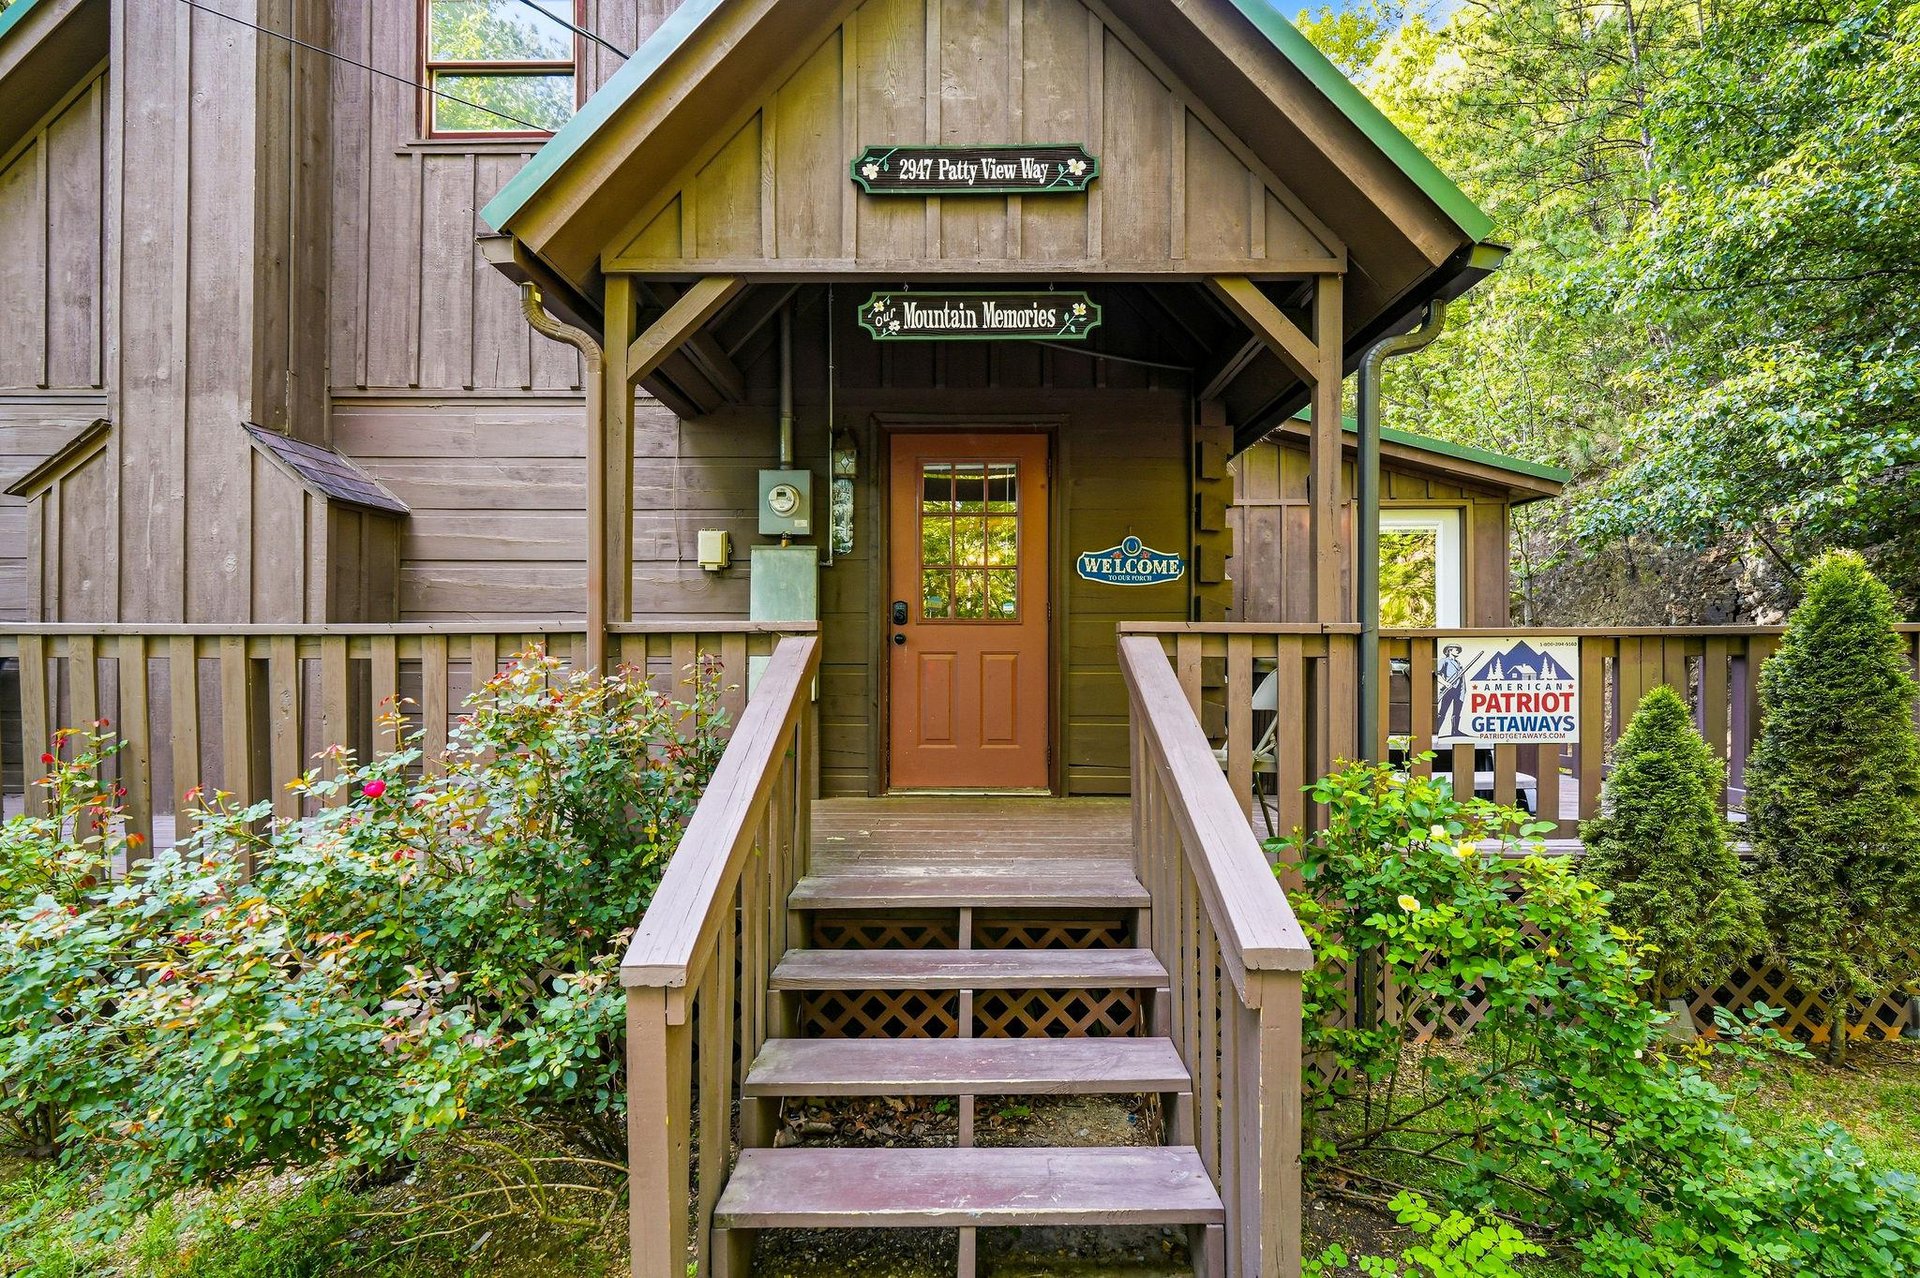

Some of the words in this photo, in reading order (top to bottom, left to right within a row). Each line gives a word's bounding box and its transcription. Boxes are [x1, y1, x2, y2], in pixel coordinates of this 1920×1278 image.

[900, 159, 932, 180] 2947
[938, 159, 978, 185] Patty
[981, 158, 1016, 179] View
[1020, 157, 1049, 184] Way
[903, 302, 977, 329] Mountain
[982, 301, 1056, 329] Memories
[1083, 557, 1179, 574] WELCOME
[1484, 683, 1563, 691] AMERICAN
[1471, 692, 1574, 713] PATRIOT
[1471, 715, 1575, 732] GETAWAYS
